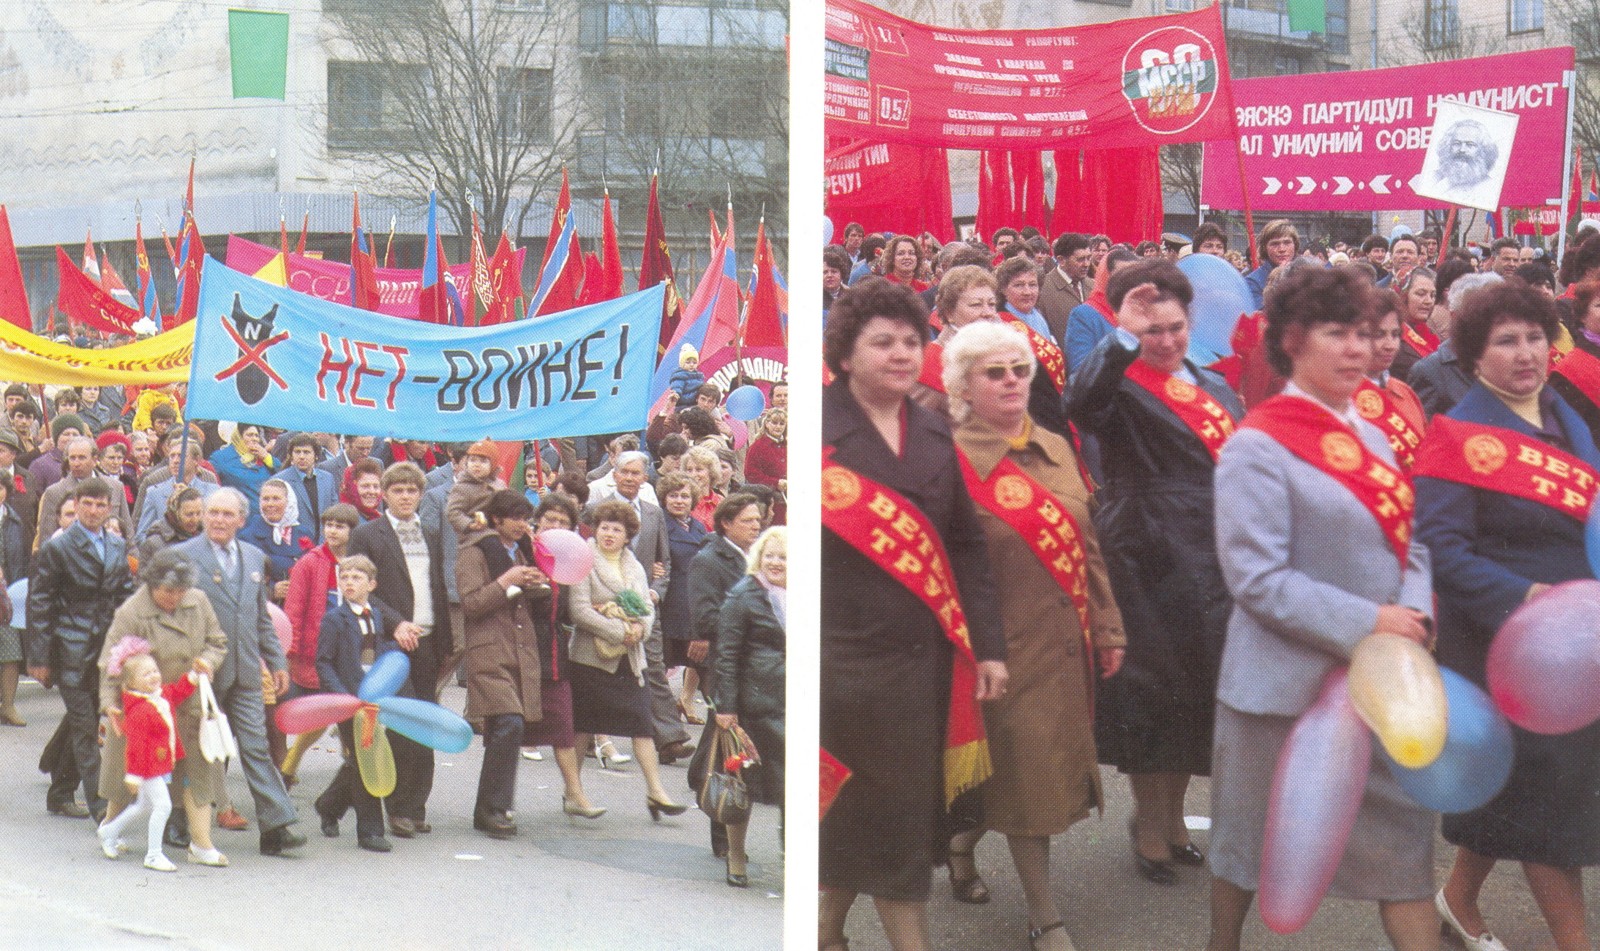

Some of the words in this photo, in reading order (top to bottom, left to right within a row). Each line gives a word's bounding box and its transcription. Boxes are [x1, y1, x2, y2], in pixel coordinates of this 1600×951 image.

[1303, 97, 1413, 126] ПАРТИДУЛ
[1240, 134, 1263, 156] АЛ
[1272, 125, 1364, 158] УНИУНИЙ
[244, 321, 263, 341] N
[1517, 443, 1600, 490] ВЕТ
